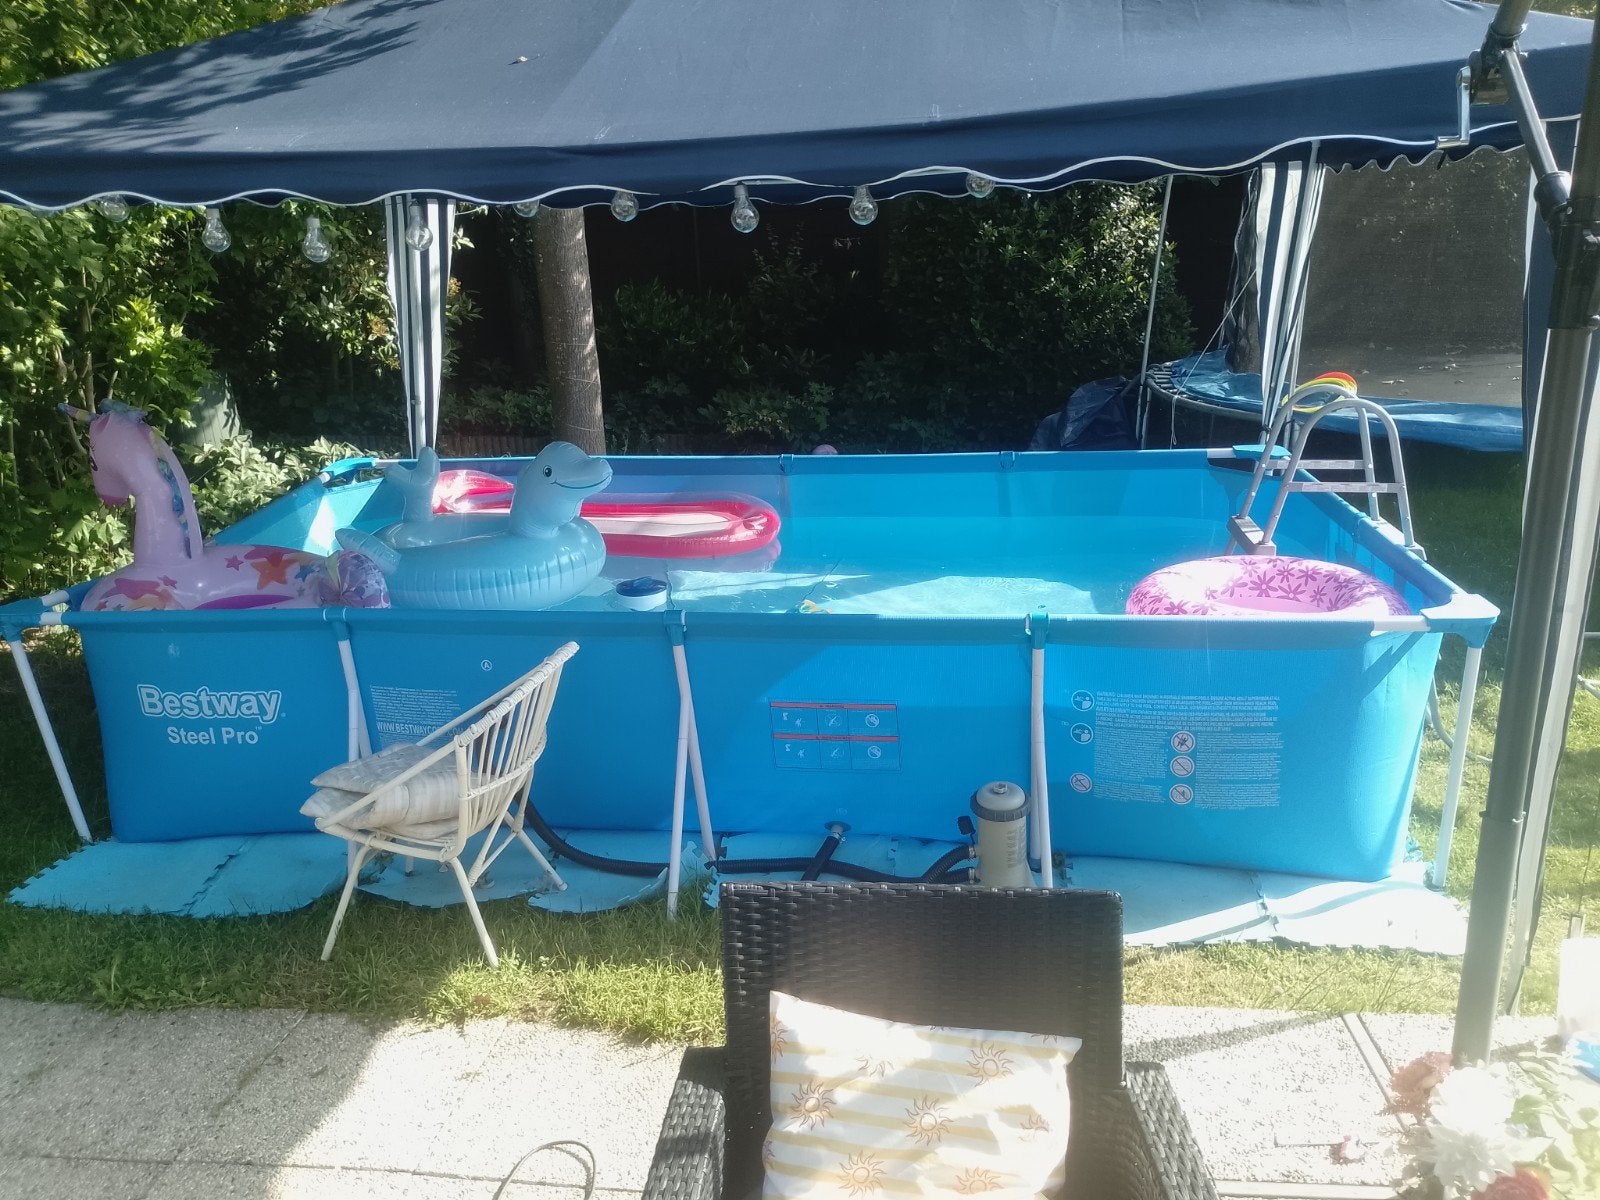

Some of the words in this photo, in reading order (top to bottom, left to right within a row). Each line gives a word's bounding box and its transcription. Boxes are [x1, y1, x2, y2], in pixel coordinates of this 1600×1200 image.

[138, 685, 281, 723] Bestway
[167, 726, 215, 744] Steel
[221, 727, 259, 744] Pro
